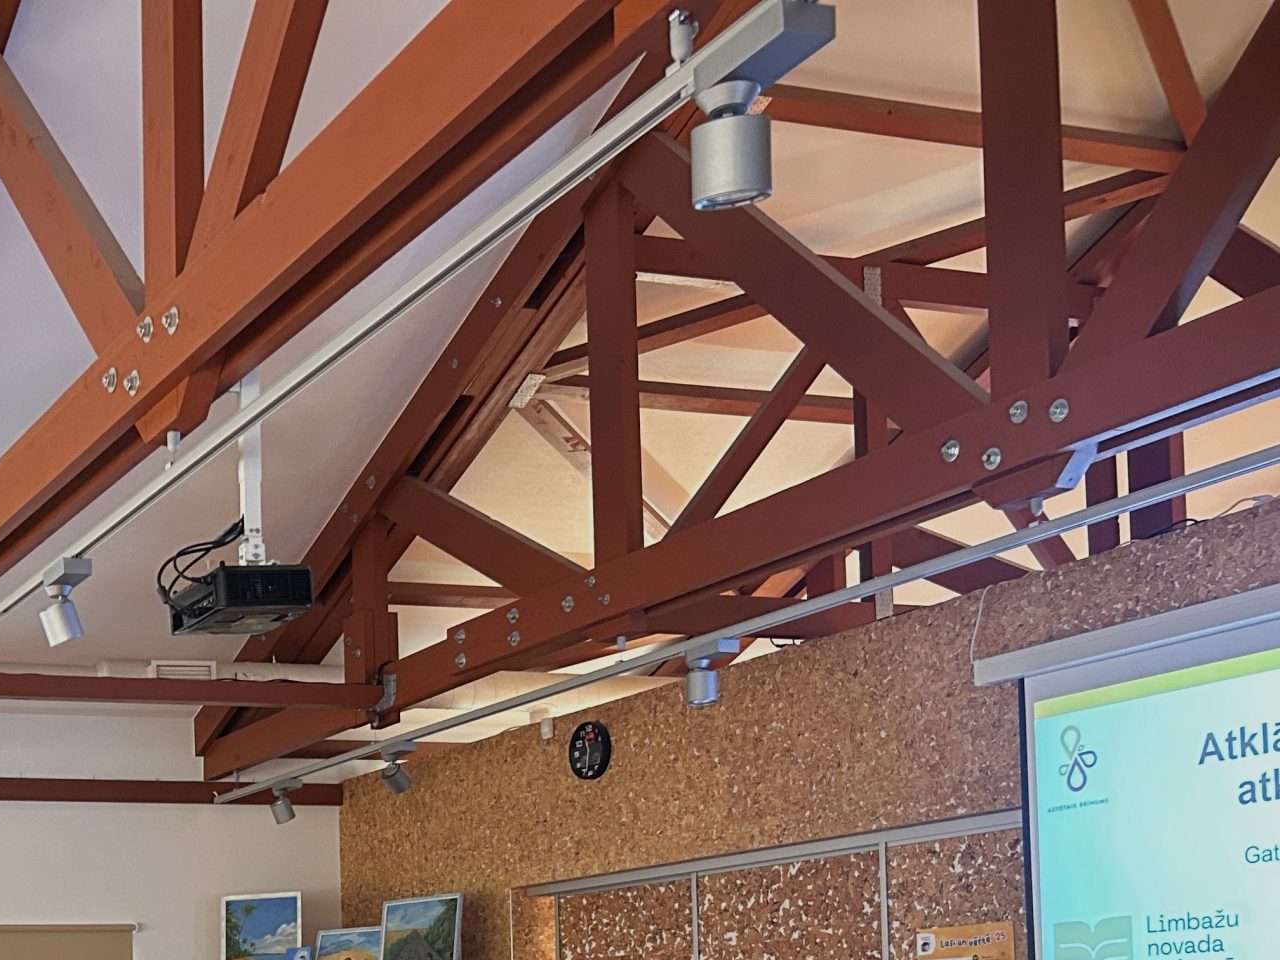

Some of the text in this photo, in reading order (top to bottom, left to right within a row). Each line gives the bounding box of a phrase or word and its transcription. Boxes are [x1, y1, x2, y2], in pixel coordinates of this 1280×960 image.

[1146, 909, 1239, 933] Limbažu
[995, 931, 1006, 941] 25
[1147, 933, 1225, 956] novada
